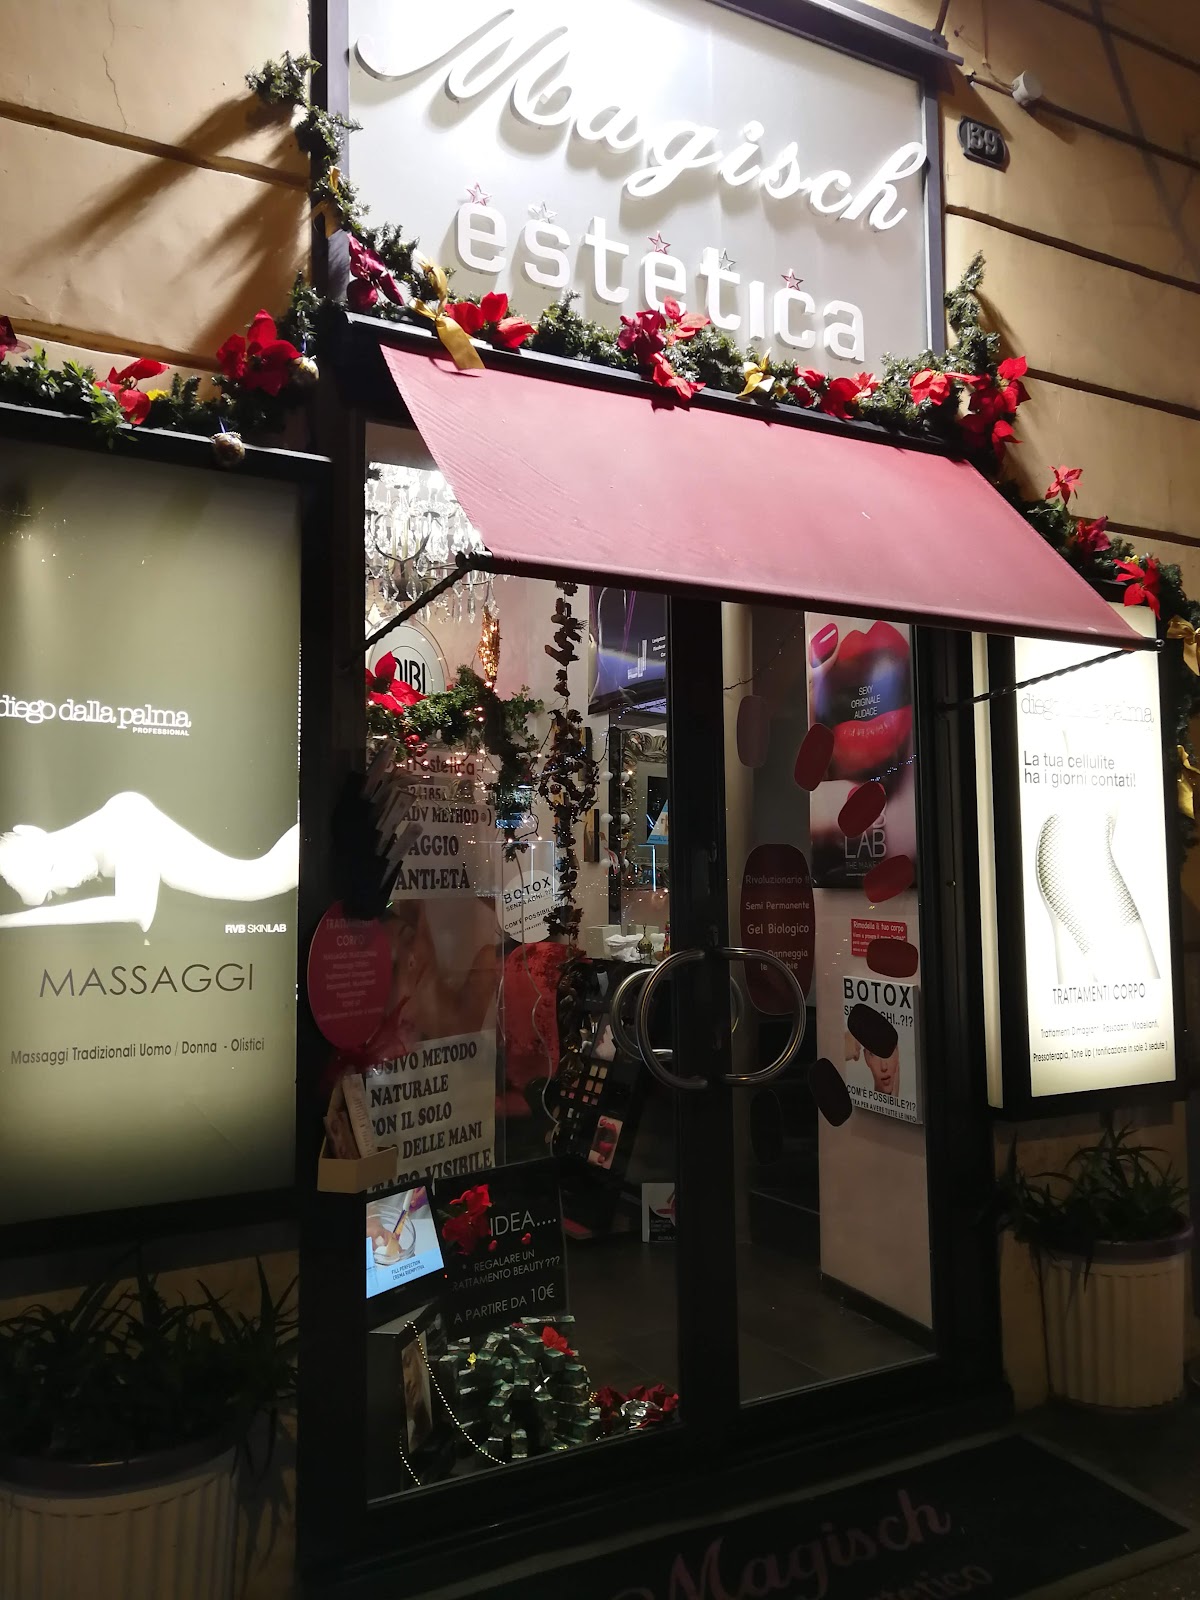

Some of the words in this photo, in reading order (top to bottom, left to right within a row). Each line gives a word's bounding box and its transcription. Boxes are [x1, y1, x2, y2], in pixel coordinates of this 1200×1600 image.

[352, 7, 928, 233] Magisch
[453, 201, 867, 363] estetica
[850, 694, 881, 709] ORIGINALE
[858, 685, 874, 696] SEXY
[0, 694, 57, 724] diego
[58, 699, 117, 724] dalla
[117, 704, 192, 730] palma
[854, 706, 878, 719] AUDACE
[132, 726, 190, 737] PROFESSIONAL
[1023, 750, 1040, 767] La
[1043, 752, 1064, 767] tua
[1067, 754, 1116, 770] cellulite
[1024, 768, 1041, 784] ha
[1051, 769, 1088, 789] giorni
[1091, 773, 1137, 788] contati!
[432, 806, 478, 824] METHOD
[845, 828, 887, 858] LAB
[503, 876, 551, 904] BOTOX
[745, 874, 803, 885] Rivoluzionario
[745, 901, 764, 911] Semi
[766, 900, 811, 911] Permanente
[225, 924, 246, 934] RVB
[247, 923, 287, 933] SKINLAB
[747, 923, 764, 935] Gel
[768, 922, 810, 937] Biologico
[853, 920, 875, 930] Rimodella
[891, 924, 905, 934] corpo
[39, 962, 254, 998] MASSAGGI
[844, 978, 912, 1012] BOTOX
[1052, 985, 1110, 1005] TRATTAMENTI
[1112, 982, 1146, 1001] CORPO
[11, 1049, 69, 1066] Massaggi
[71, 1043, 137, 1061] Tradizionali
[139, 1042, 173, 1057] Uomo
[181, 1040, 218, 1055] Donna
[230, 1037, 265, 1052] Olistici
[423, 1041, 478, 1068] METODO
[370, 1074, 449, 1108] NATURALE
[401, 1110, 415, 1131] IL
[418, 1101, 453, 1126] SOLO
[402, 1131, 446, 1159] DELLE
[448, 1121, 482, 1147] MANI
[425, 1148, 492, 1180] VISIBILE
[490, 1210, 557, 1237] IDEA....
[474, 1255, 521, 1273] REGALARE
[522, 1249, 535, 1260] UN
[453, 1269, 511, 1291] RATTAMENTO
[454, 1312, 463, 1325] A
[465, 1299, 508, 1321] PARTIRE
[511, 1295, 527, 1309] DA
[531, 1283, 555, 1303] 10€
